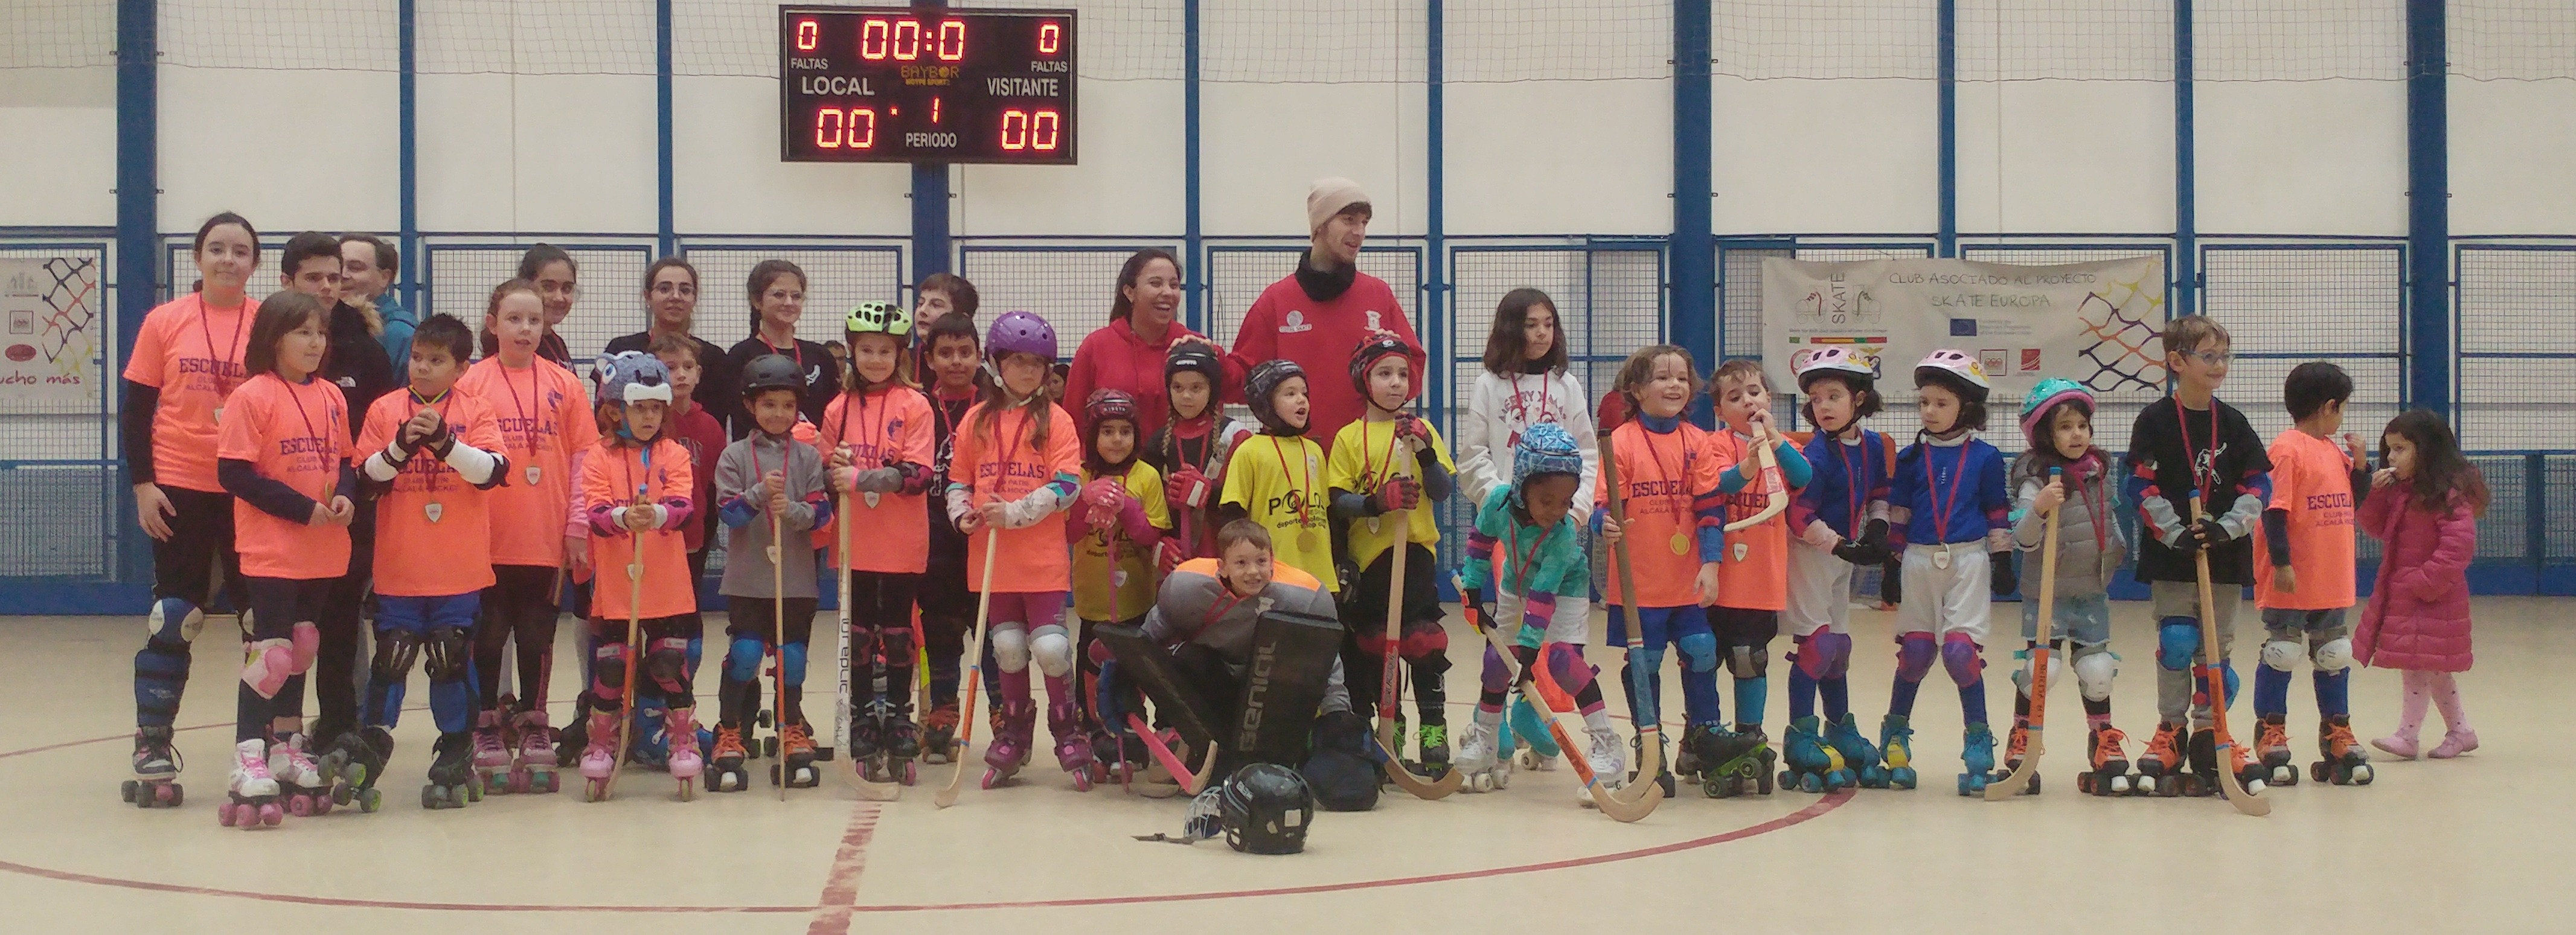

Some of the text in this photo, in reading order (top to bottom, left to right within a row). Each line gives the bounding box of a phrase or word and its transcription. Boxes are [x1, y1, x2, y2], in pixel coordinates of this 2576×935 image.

[798, 21, 818, 50] 0
[862, 19, 965, 60] 00:0
[1039, 24, 1059, 53] 0
[790, 58, 828, 70] FALTAS
[1031, 61, 1068, 72] FALTAS
[802, 76, 875, 96] LOCAL
[987, 78, 1059, 97] VISITANTE
[817, 108, 874, 149] 00
[1001, 111, 1059, 150] 00
[906, 132, 957, 148] PERIODO
[1889, 272, 2097, 285] CLUB ASOCIADO AL PROYECTO
[1830, 272, 1847, 324] SKATE
[1932, 294, 2051, 307] SKATE EUROPA
[46, 372, 80, 384] más
